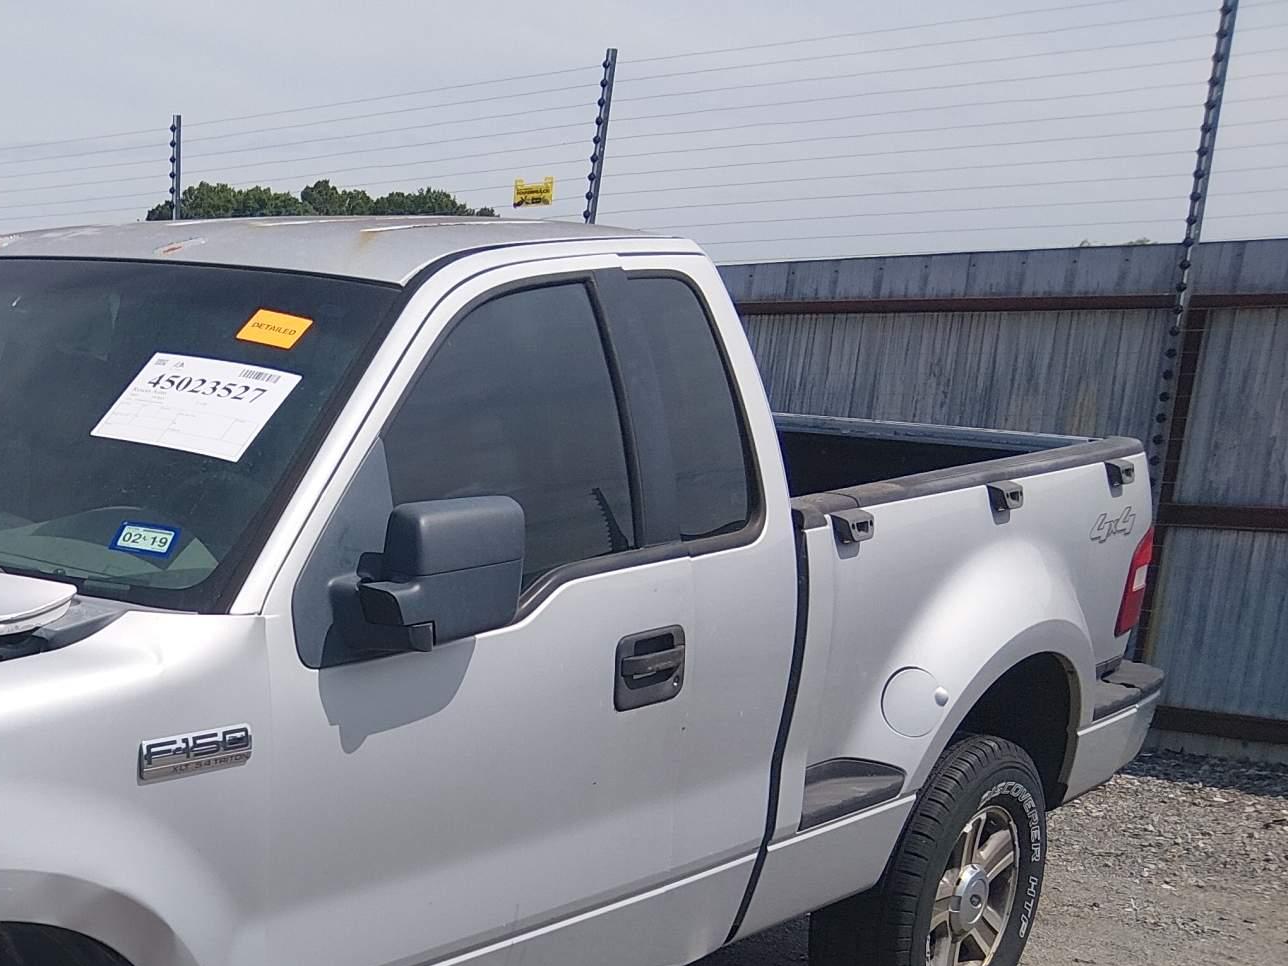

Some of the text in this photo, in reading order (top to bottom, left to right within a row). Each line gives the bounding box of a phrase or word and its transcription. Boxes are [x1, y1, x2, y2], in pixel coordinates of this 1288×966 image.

[251, 321, 297, 337] DETAILED
[147, 373, 268, 404] 45023527
[1089, 505, 1137, 544] 4x4
[144, 727, 250, 765] F-150
